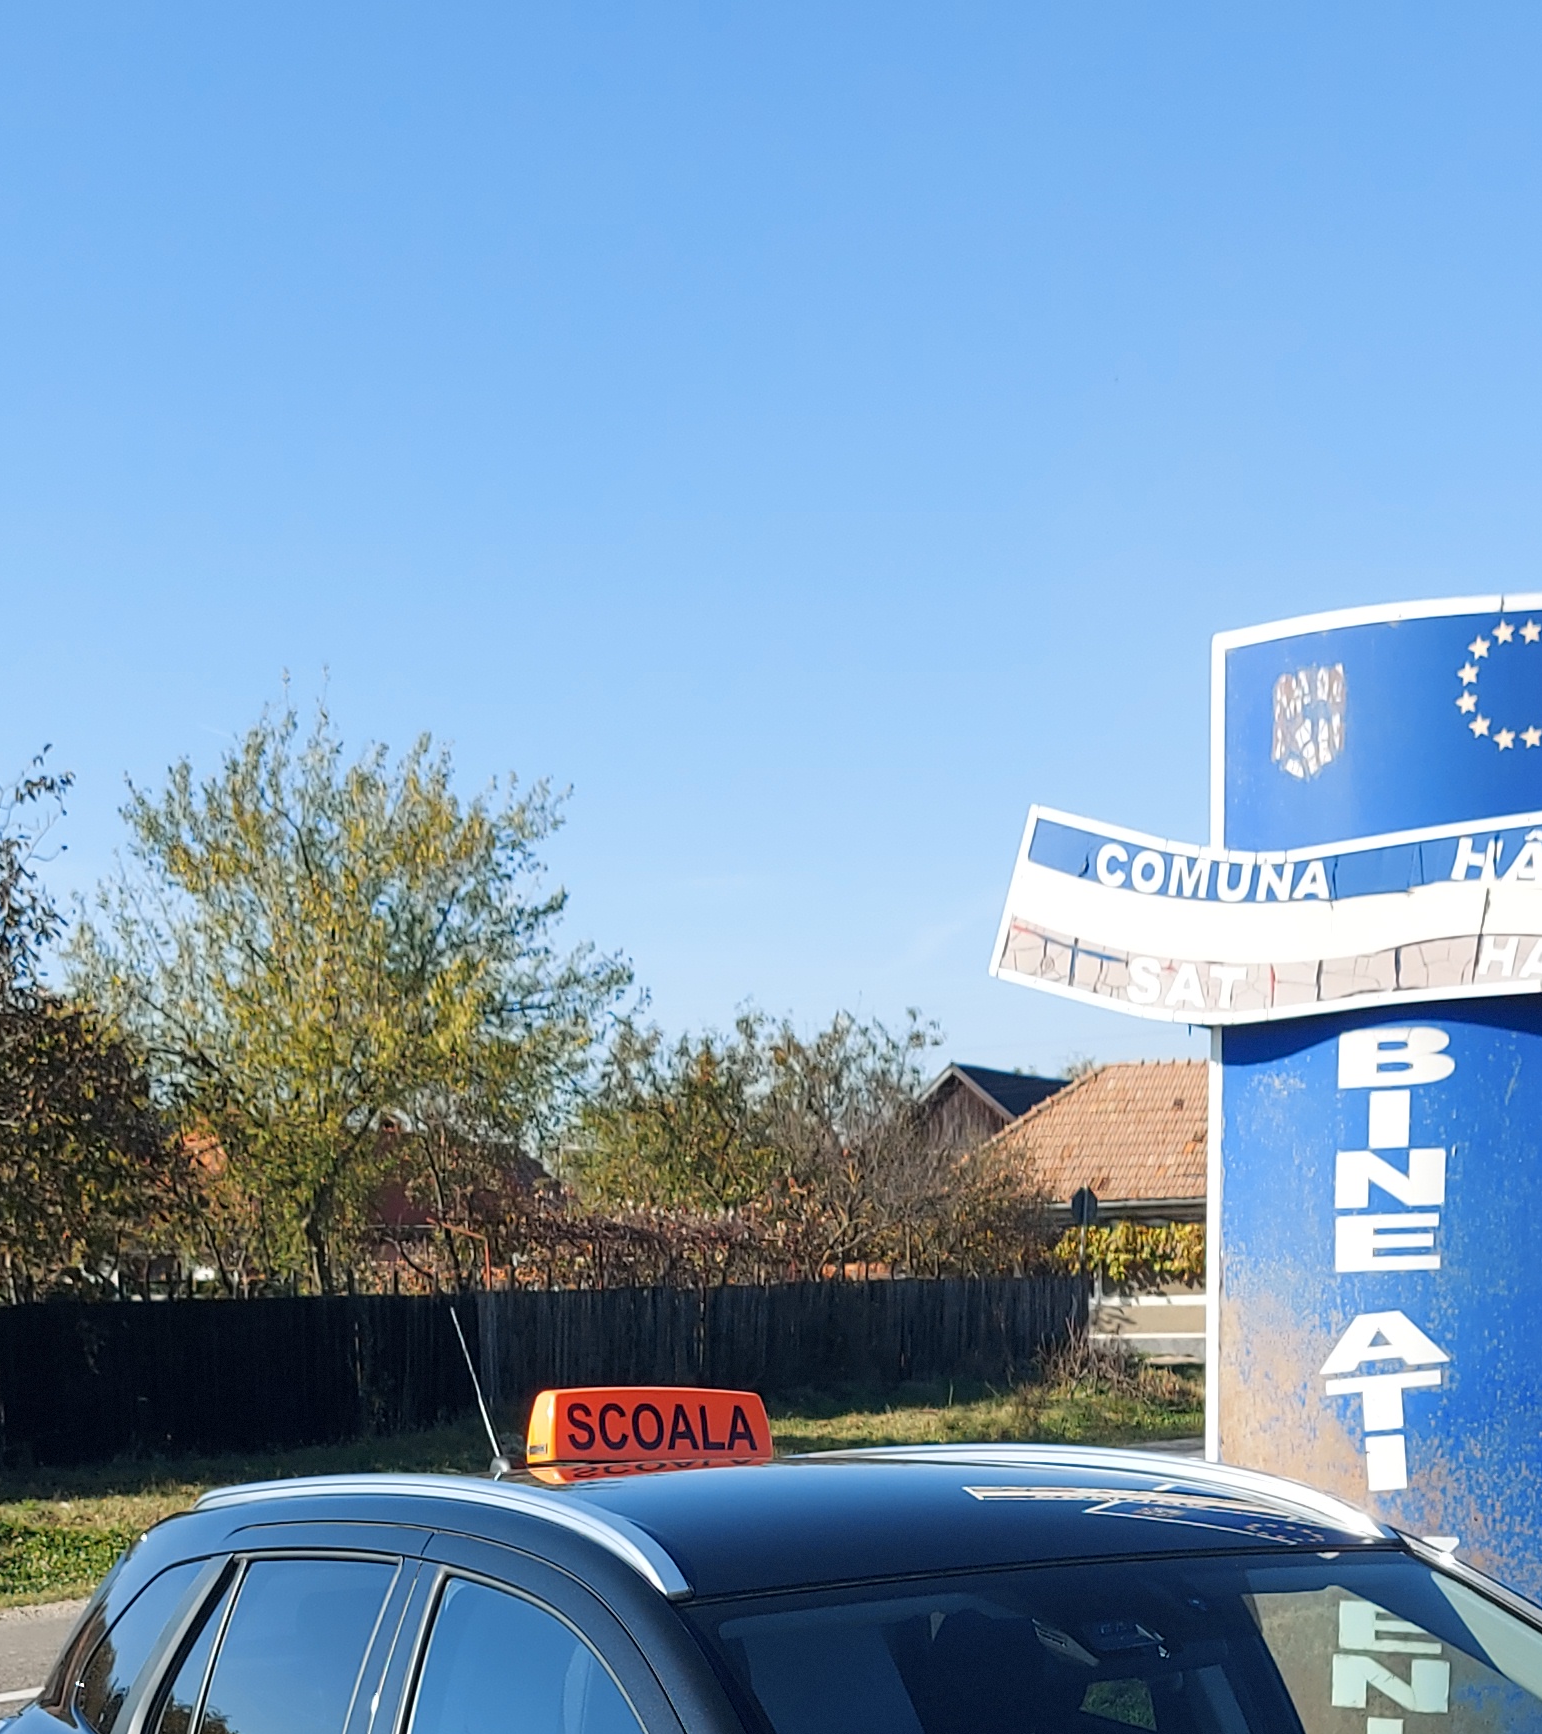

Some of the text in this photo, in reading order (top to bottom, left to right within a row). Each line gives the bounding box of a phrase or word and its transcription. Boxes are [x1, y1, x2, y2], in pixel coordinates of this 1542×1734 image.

[1096, 843, 1331, 903] COMUNA
[1126, 956, 1249, 1009] SAT
[1333, 1027, 1456, 1273] BINE
[567, 1403, 757, 1451] SCOALA
[1320, 1310, 1451, 1492] ATI
